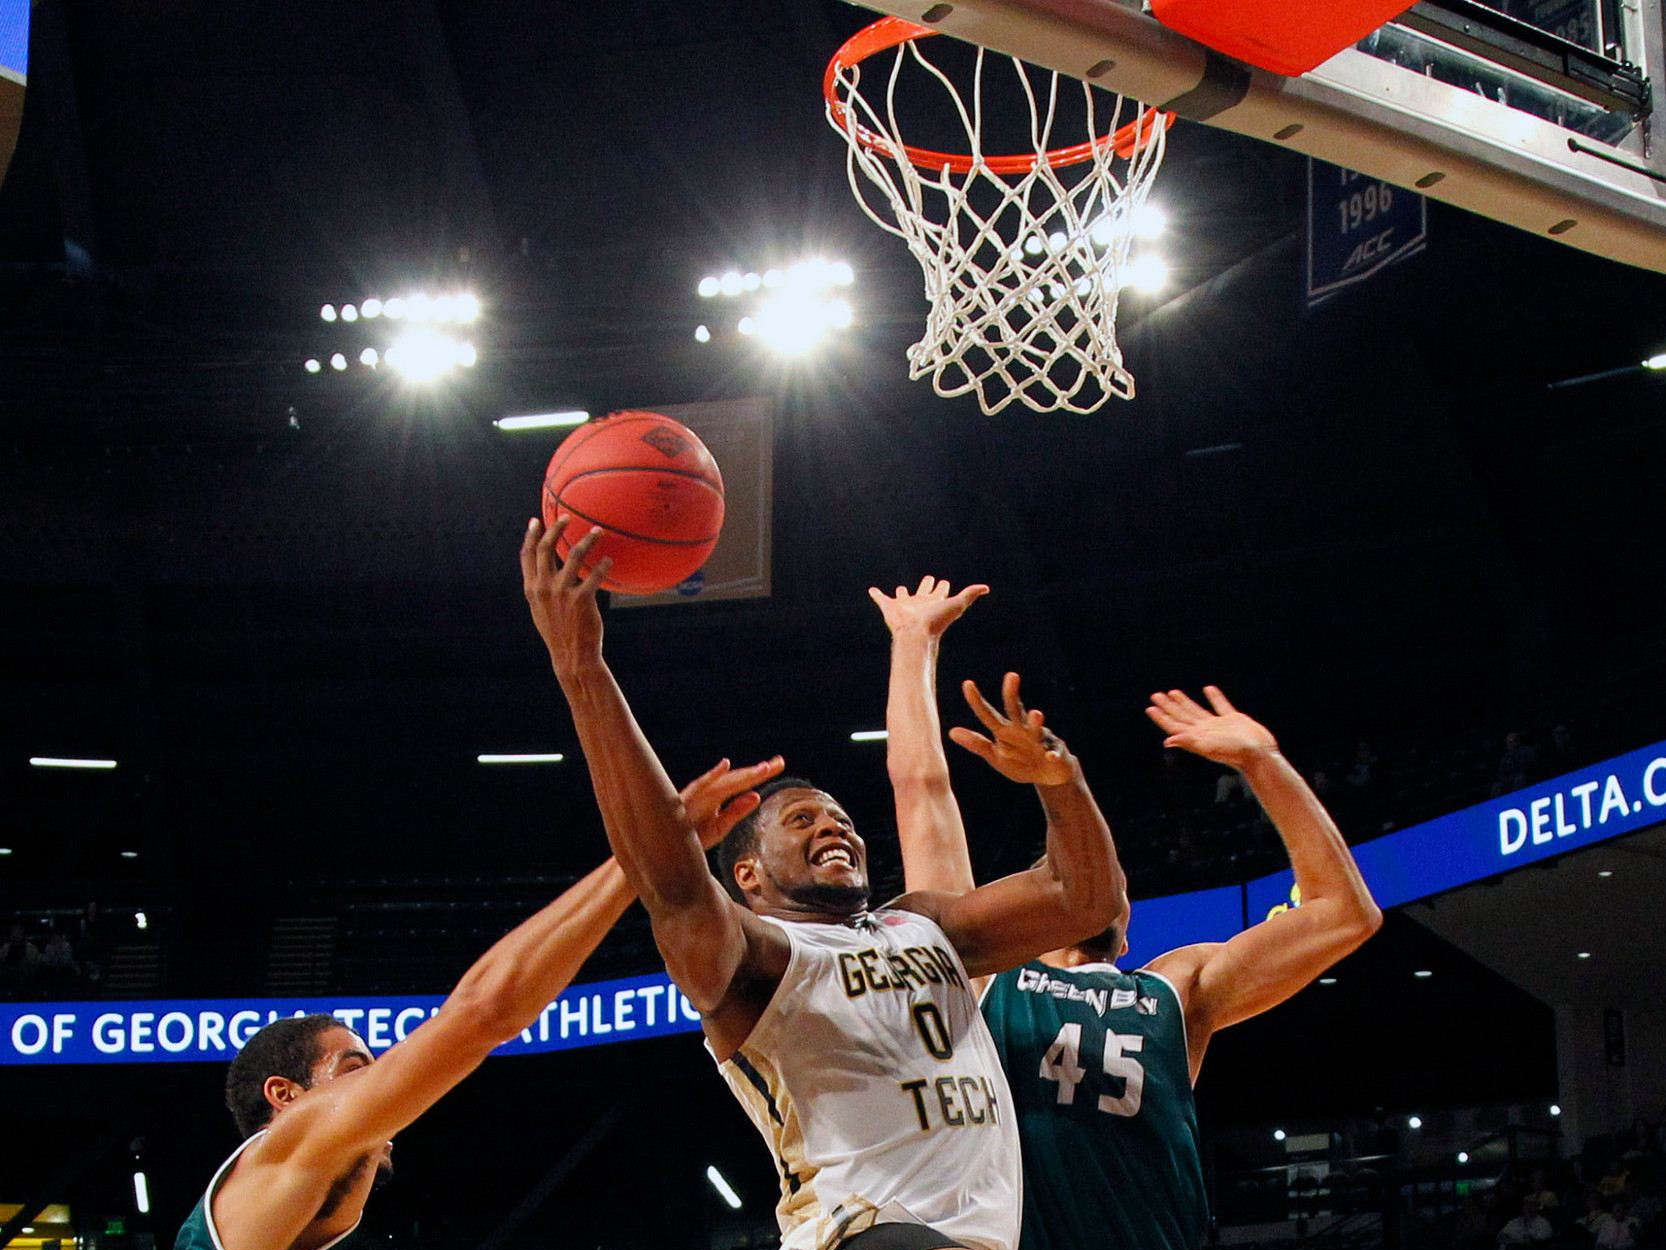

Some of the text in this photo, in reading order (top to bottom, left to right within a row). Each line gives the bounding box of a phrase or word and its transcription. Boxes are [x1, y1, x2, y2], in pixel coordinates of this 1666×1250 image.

[1339, 182, 1394, 234] 1996
[1342, 226, 1395, 270] ACC
[11, 983, 701, 1055] OF GEORG TEC THLETIC
[913, 1002, 953, 1062] 0
[1039, 1022, 1145, 1118] 45
[901, 1076, 1001, 1132] TECH
